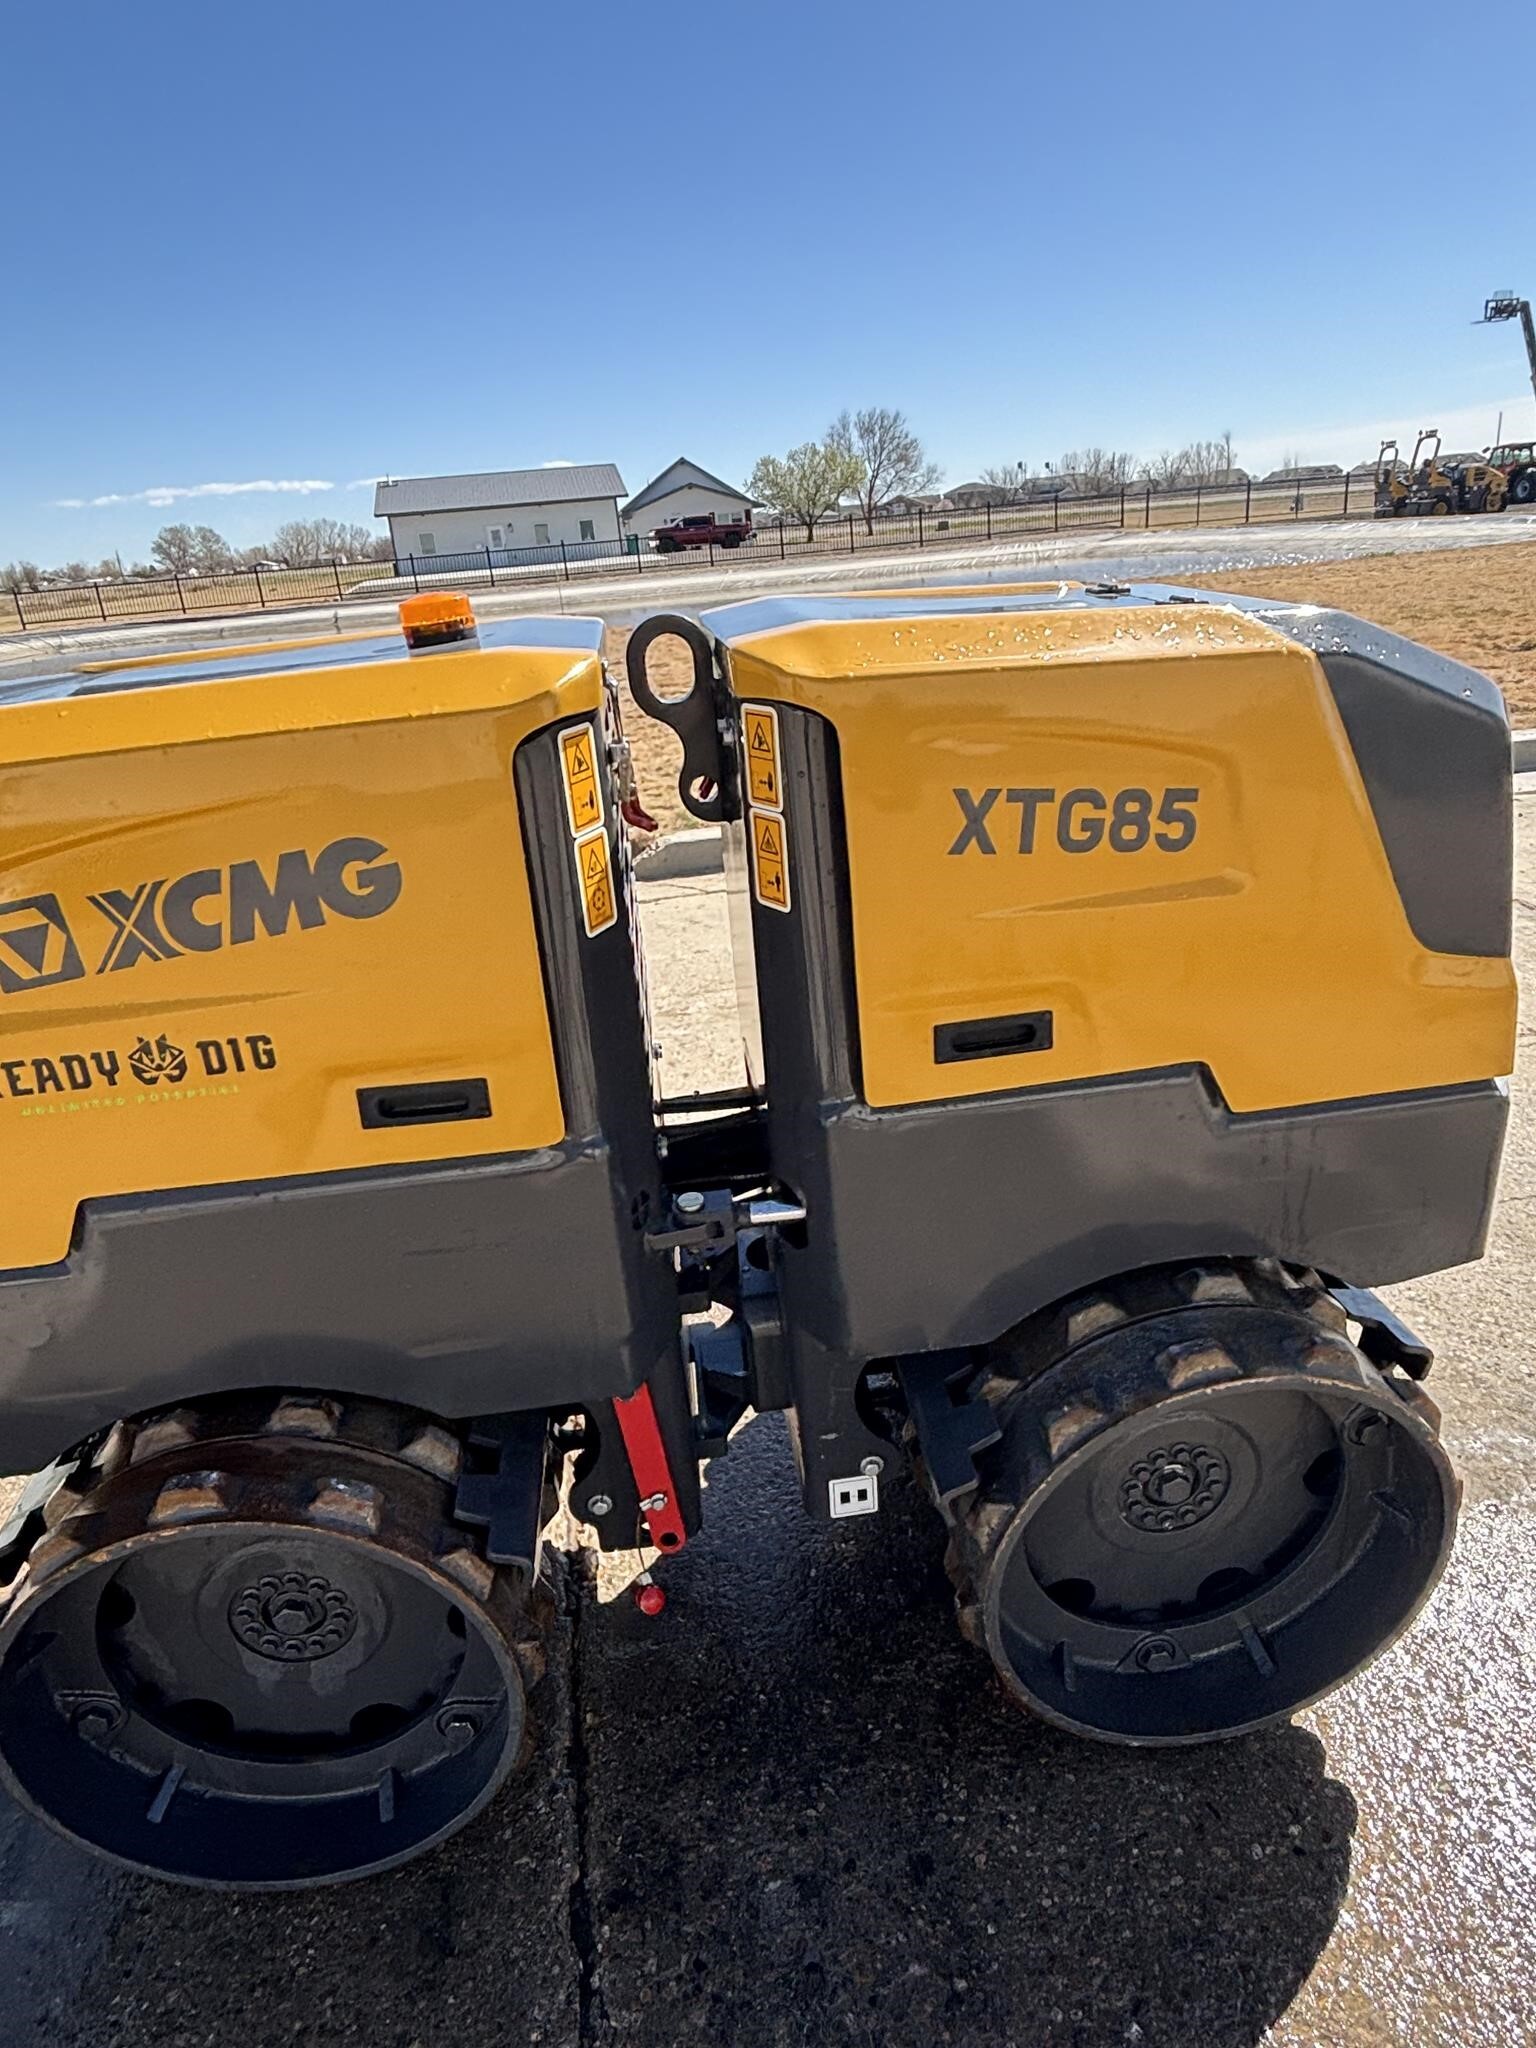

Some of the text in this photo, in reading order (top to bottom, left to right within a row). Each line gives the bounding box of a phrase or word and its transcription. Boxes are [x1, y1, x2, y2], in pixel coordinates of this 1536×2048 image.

[947, 788, 1199, 854] XTG85
[87, 837, 402, 974] XCMG
[0, 1035, 276, 1098] EADY DIG
